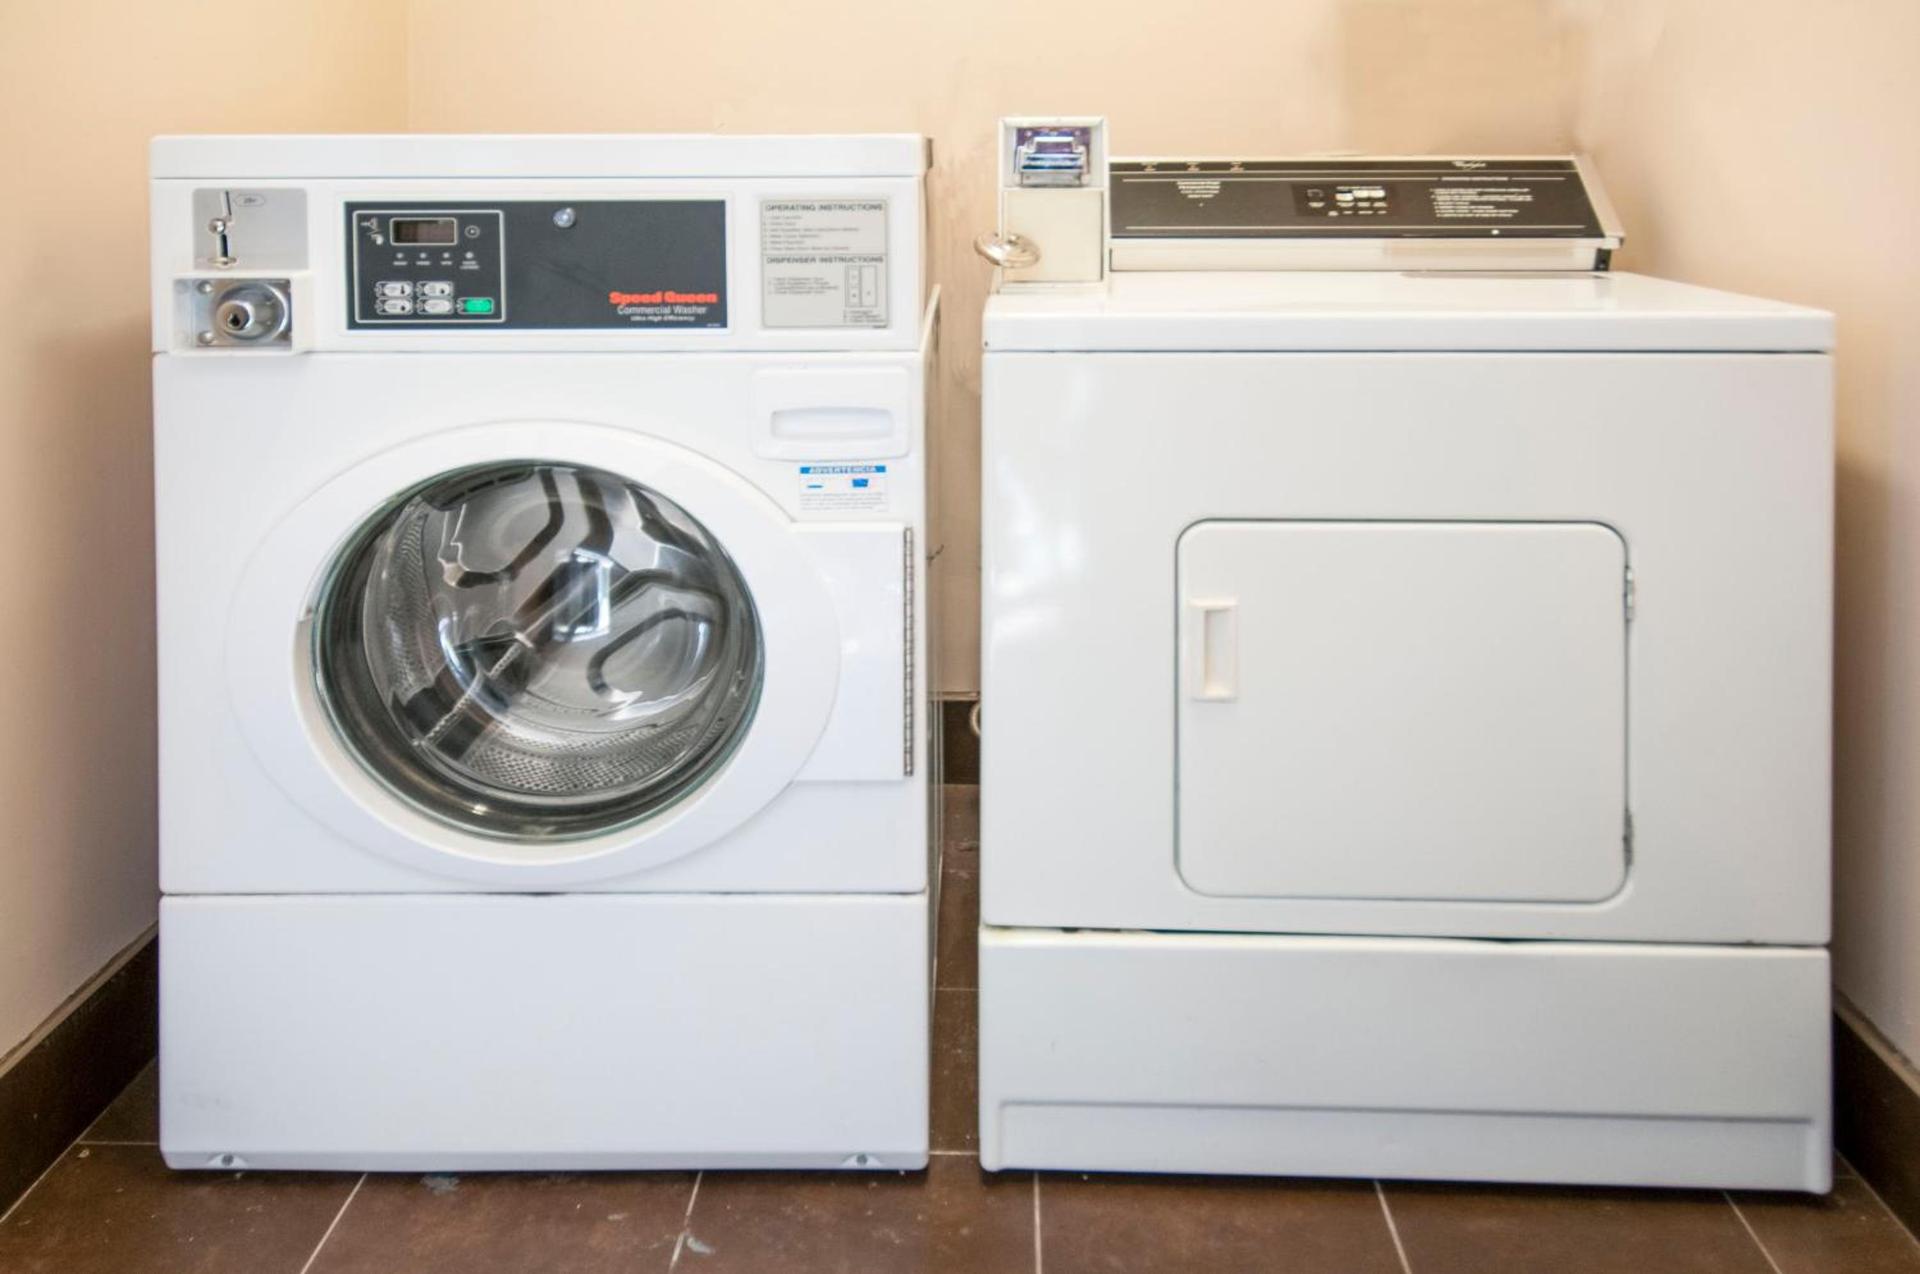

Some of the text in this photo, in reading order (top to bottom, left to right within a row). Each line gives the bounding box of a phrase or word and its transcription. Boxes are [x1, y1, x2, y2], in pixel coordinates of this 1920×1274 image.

[765, 203, 883, 211] OPERATING INSTRUCTIONS
[766, 256, 884, 264] DISPENSER INSTRUCTIONS
[609, 290, 718, 304] Speed Queen
[617, 305, 707, 314] Commercial Washer
[810, 465, 876, 474] ADVERTENCIA
